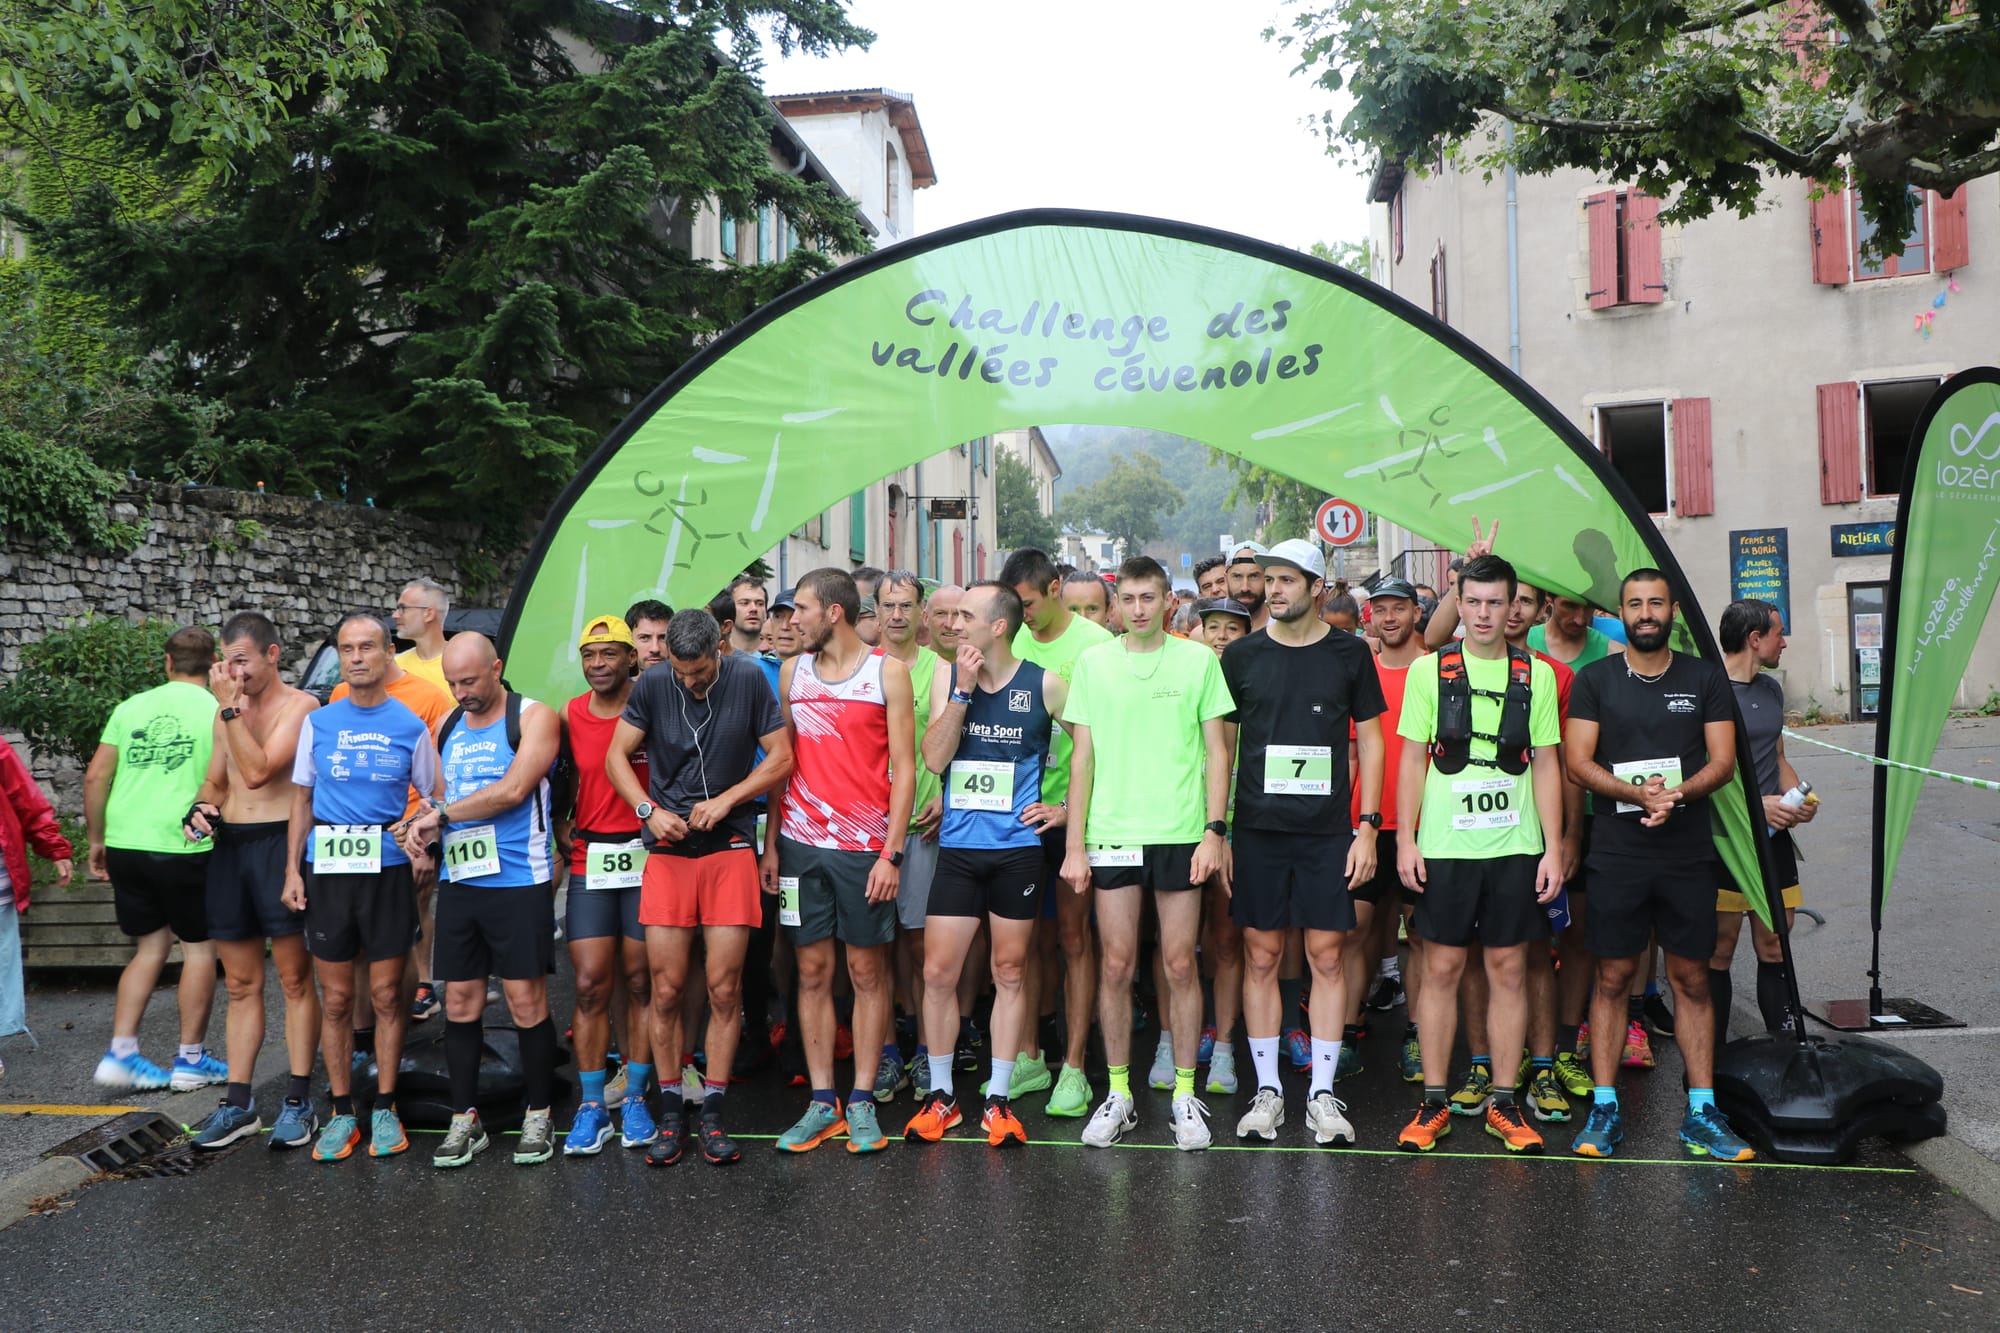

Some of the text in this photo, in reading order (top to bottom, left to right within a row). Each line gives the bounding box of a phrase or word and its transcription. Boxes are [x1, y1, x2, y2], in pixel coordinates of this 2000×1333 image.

[905, 289, 1292, 357] Challenge des
[871, 340, 1324, 392] vallées cévenoles
[969, 721, 1023, 738] Veta Sport
[1291, 759, 1307, 778] 7
[964, 774, 995, 793] 49
[1462, 790, 1509, 813] 100
[325, 838, 371, 857] 109
[449, 840, 487, 865] 110
[603, 853, 632, 872] 58
